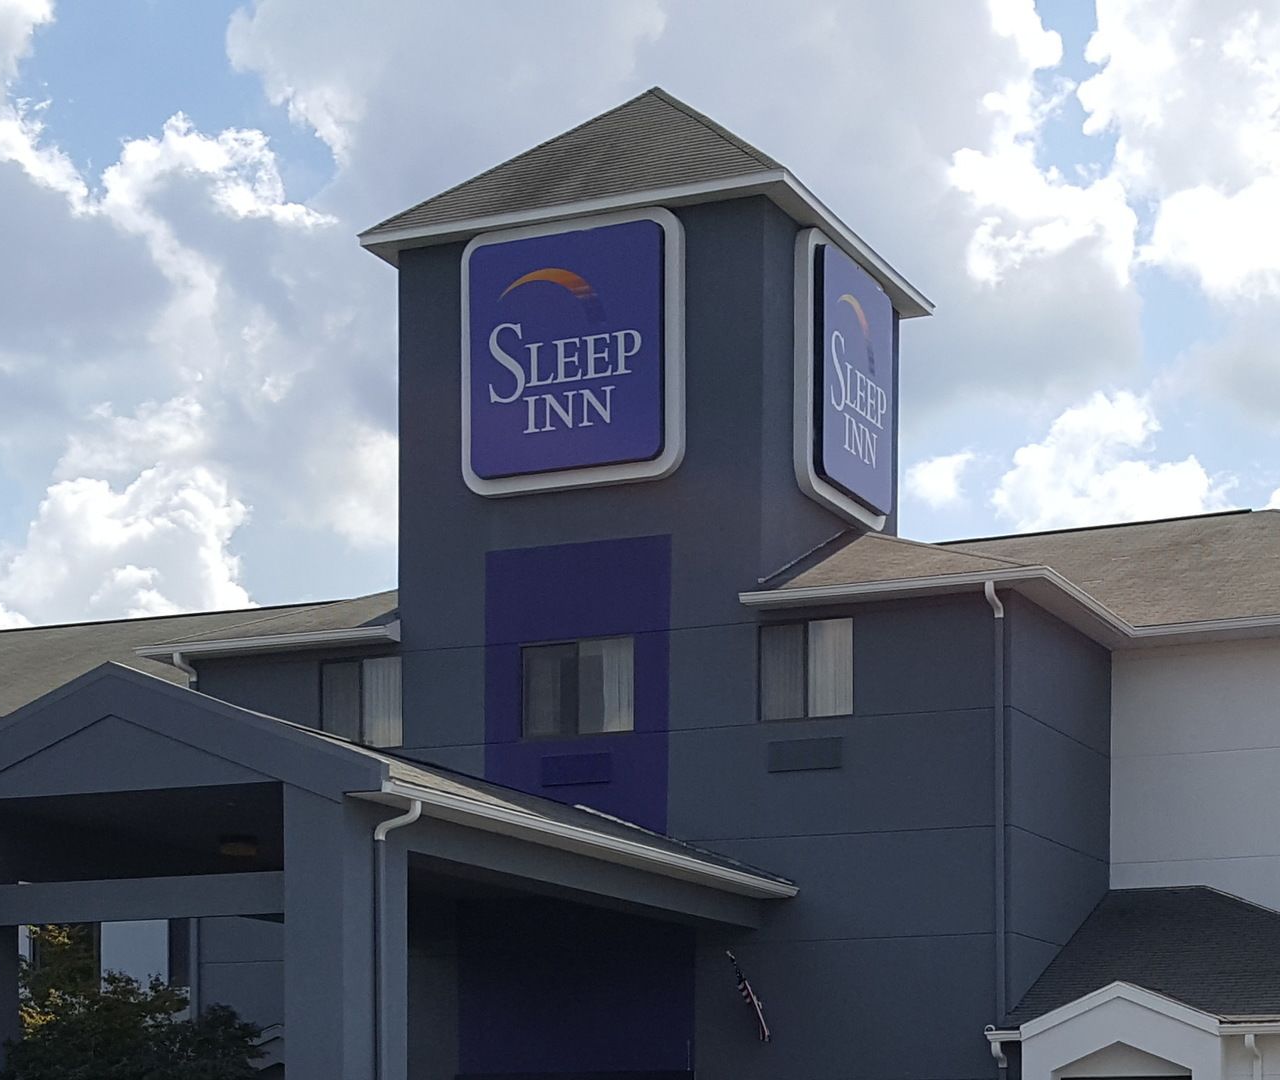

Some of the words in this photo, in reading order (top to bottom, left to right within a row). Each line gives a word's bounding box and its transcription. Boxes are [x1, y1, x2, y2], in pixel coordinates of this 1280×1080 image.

[488, 322, 642, 404] SLEEP
[830, 330, 887, 430] SLEEP
[522, 385, 616, 434] INN
[843, 412, 878, 469] INN
